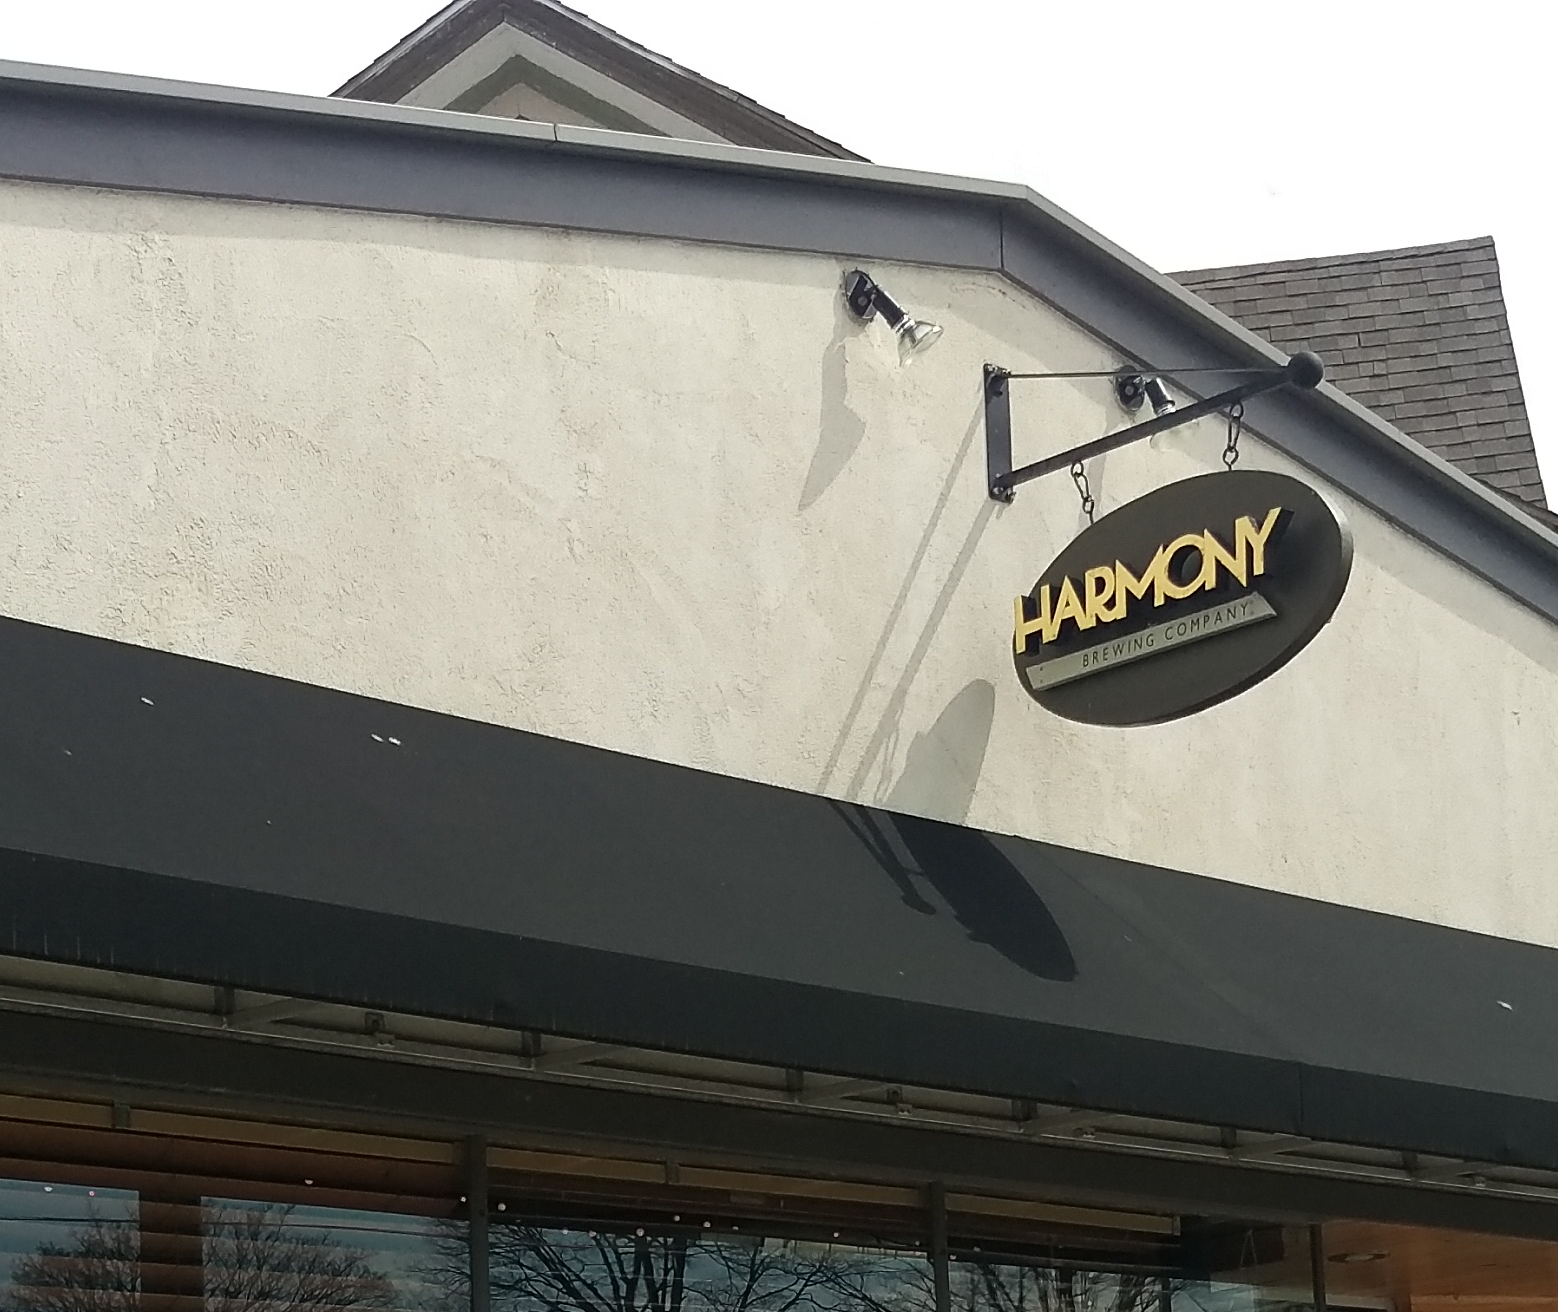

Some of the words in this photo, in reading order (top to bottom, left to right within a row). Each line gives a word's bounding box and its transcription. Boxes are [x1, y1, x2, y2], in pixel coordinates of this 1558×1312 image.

[1014, 507, 1282, 654] HARMONY
[1081, 633, 1155, 668] BREWING
[1164, 602, 1249, 642] COMPANY
